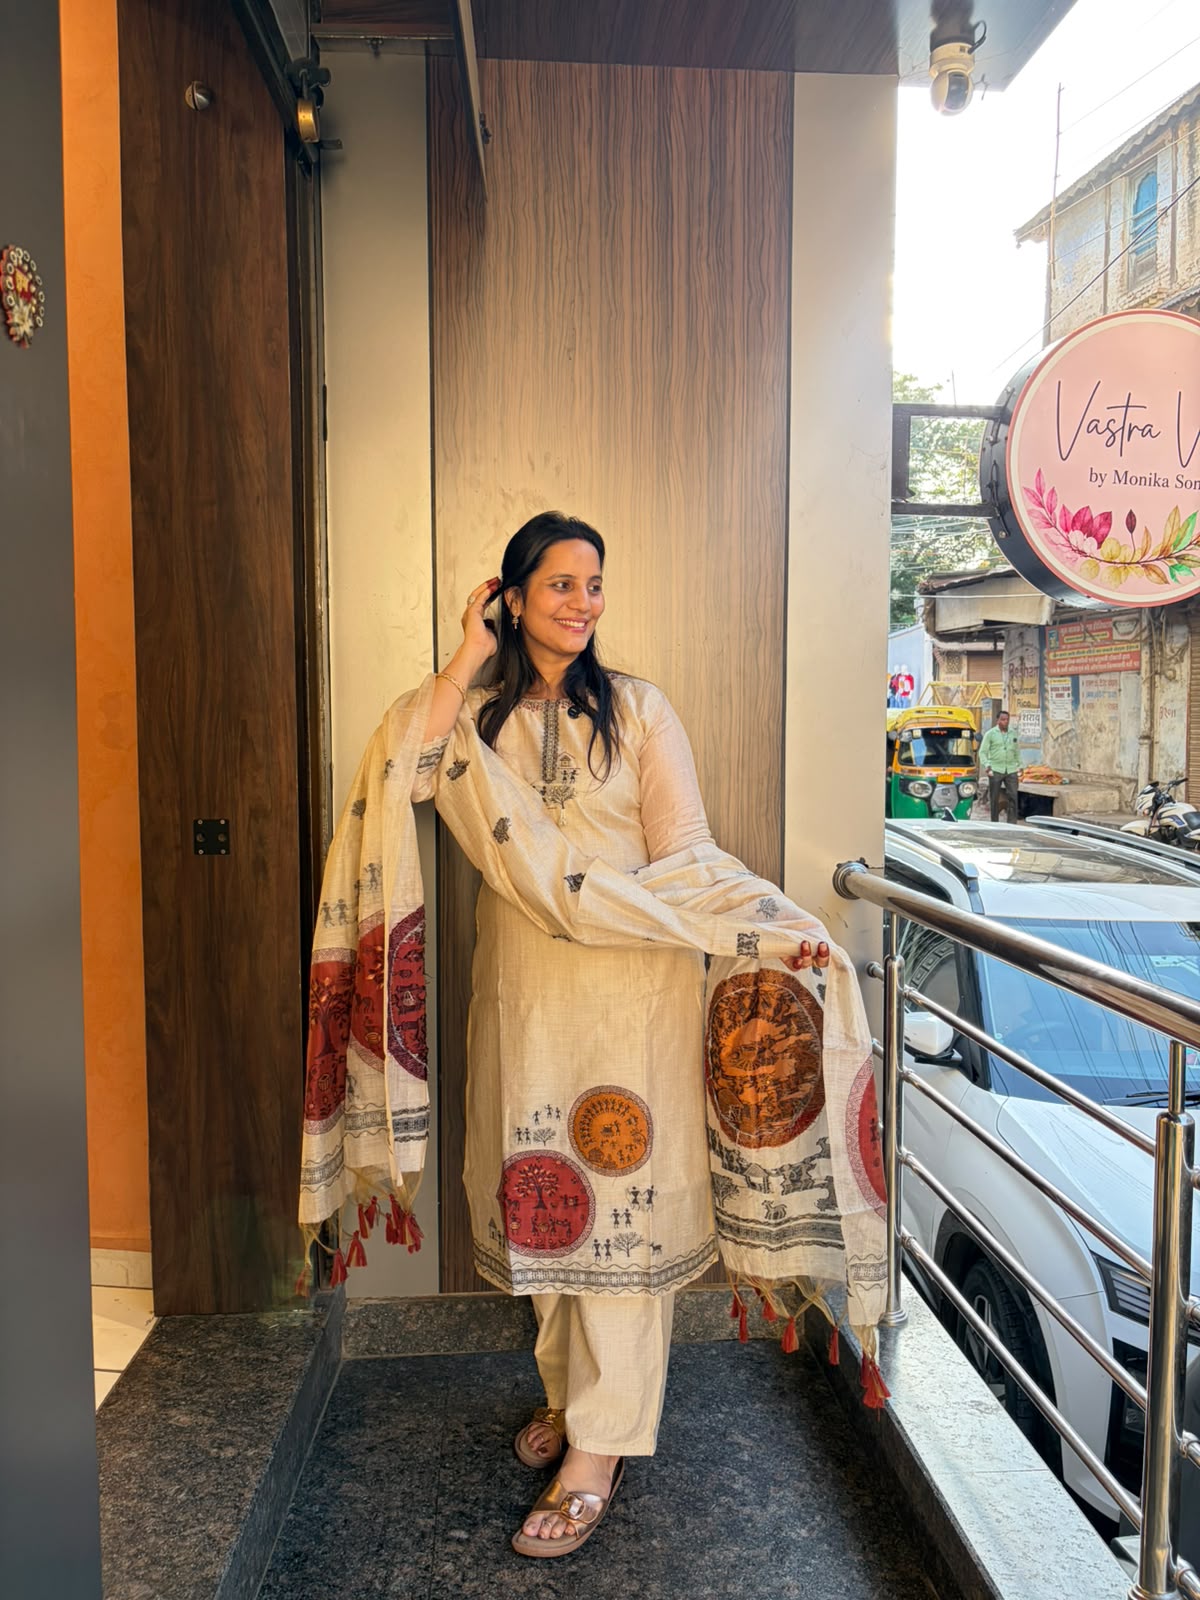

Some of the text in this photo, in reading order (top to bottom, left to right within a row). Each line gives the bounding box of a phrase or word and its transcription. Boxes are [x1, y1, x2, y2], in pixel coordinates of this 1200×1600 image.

[1056, 380, 1161, 461] Vastra
[1089, 467, 1107, 488] by
[1112, 469, 1169, 488] Monika
